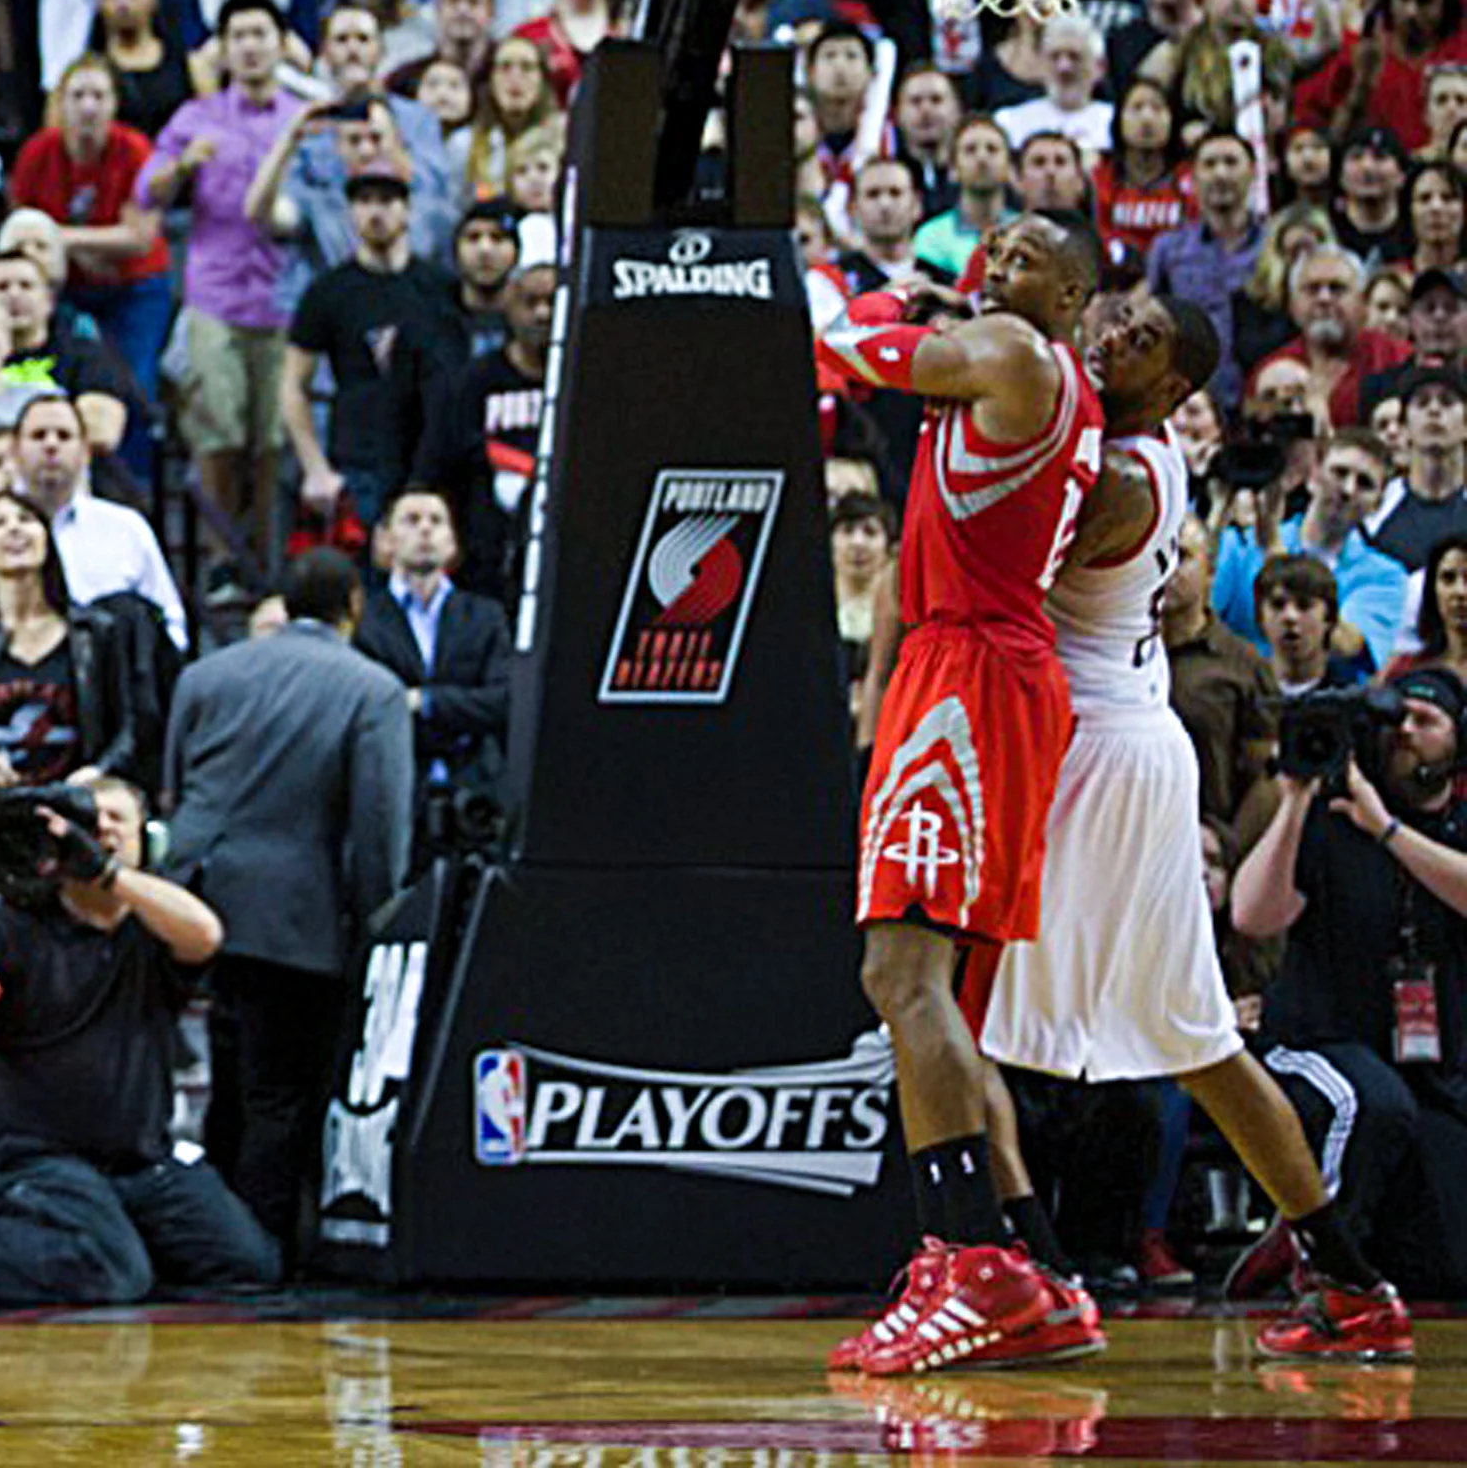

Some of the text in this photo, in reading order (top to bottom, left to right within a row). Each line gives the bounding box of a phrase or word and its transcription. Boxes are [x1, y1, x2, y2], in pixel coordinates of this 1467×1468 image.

[612, 258, 773, 300] SPALDING
[661, 480, 771, 513] PORTLAND
[635, 628, 713, 662] TRAIL
[614, 658, 722, 689] BLAZERS
[526, 1079, 889, 1150] PLAYOFFS
